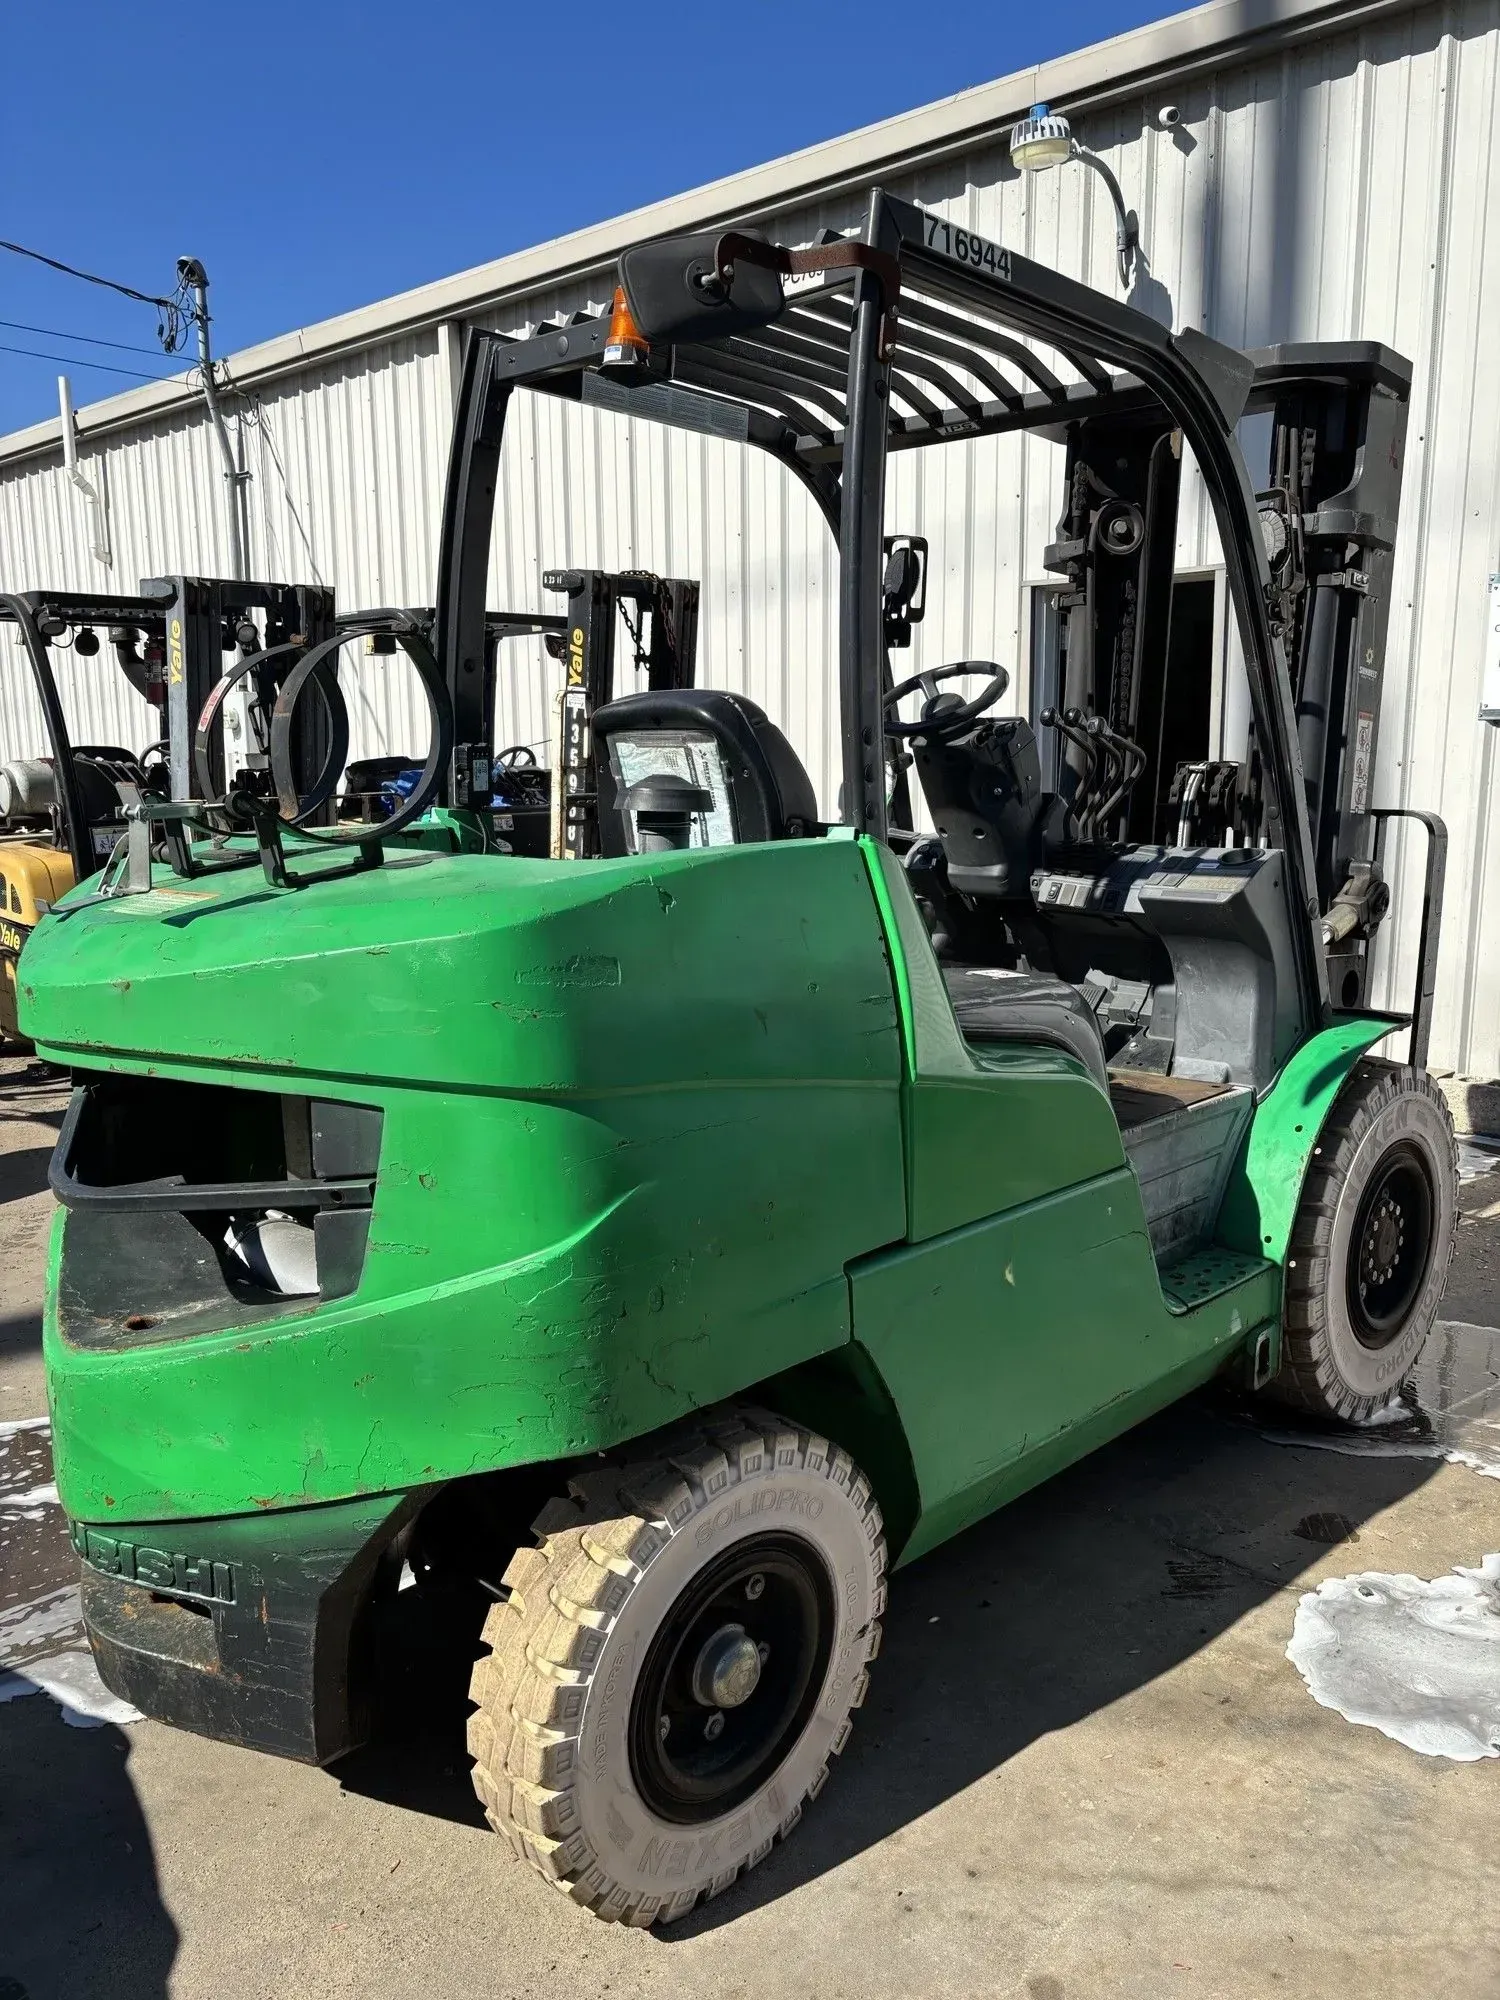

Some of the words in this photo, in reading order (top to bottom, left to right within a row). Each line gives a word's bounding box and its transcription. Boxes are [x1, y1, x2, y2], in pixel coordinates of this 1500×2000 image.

[924, 212, 1010, 280] 716944
[170, 620, 182, 684] Yale
[569, 628, 583, 685] Yale
[0, 923, 20, 950] Yale
[695, 1488, 823, 1547] SOLIDPRO
[593, 1732, 607, 1784] MADE
[601, 1643, 629, 1704] KOREA
[637, 1782, 786, 1878] NEXEN
